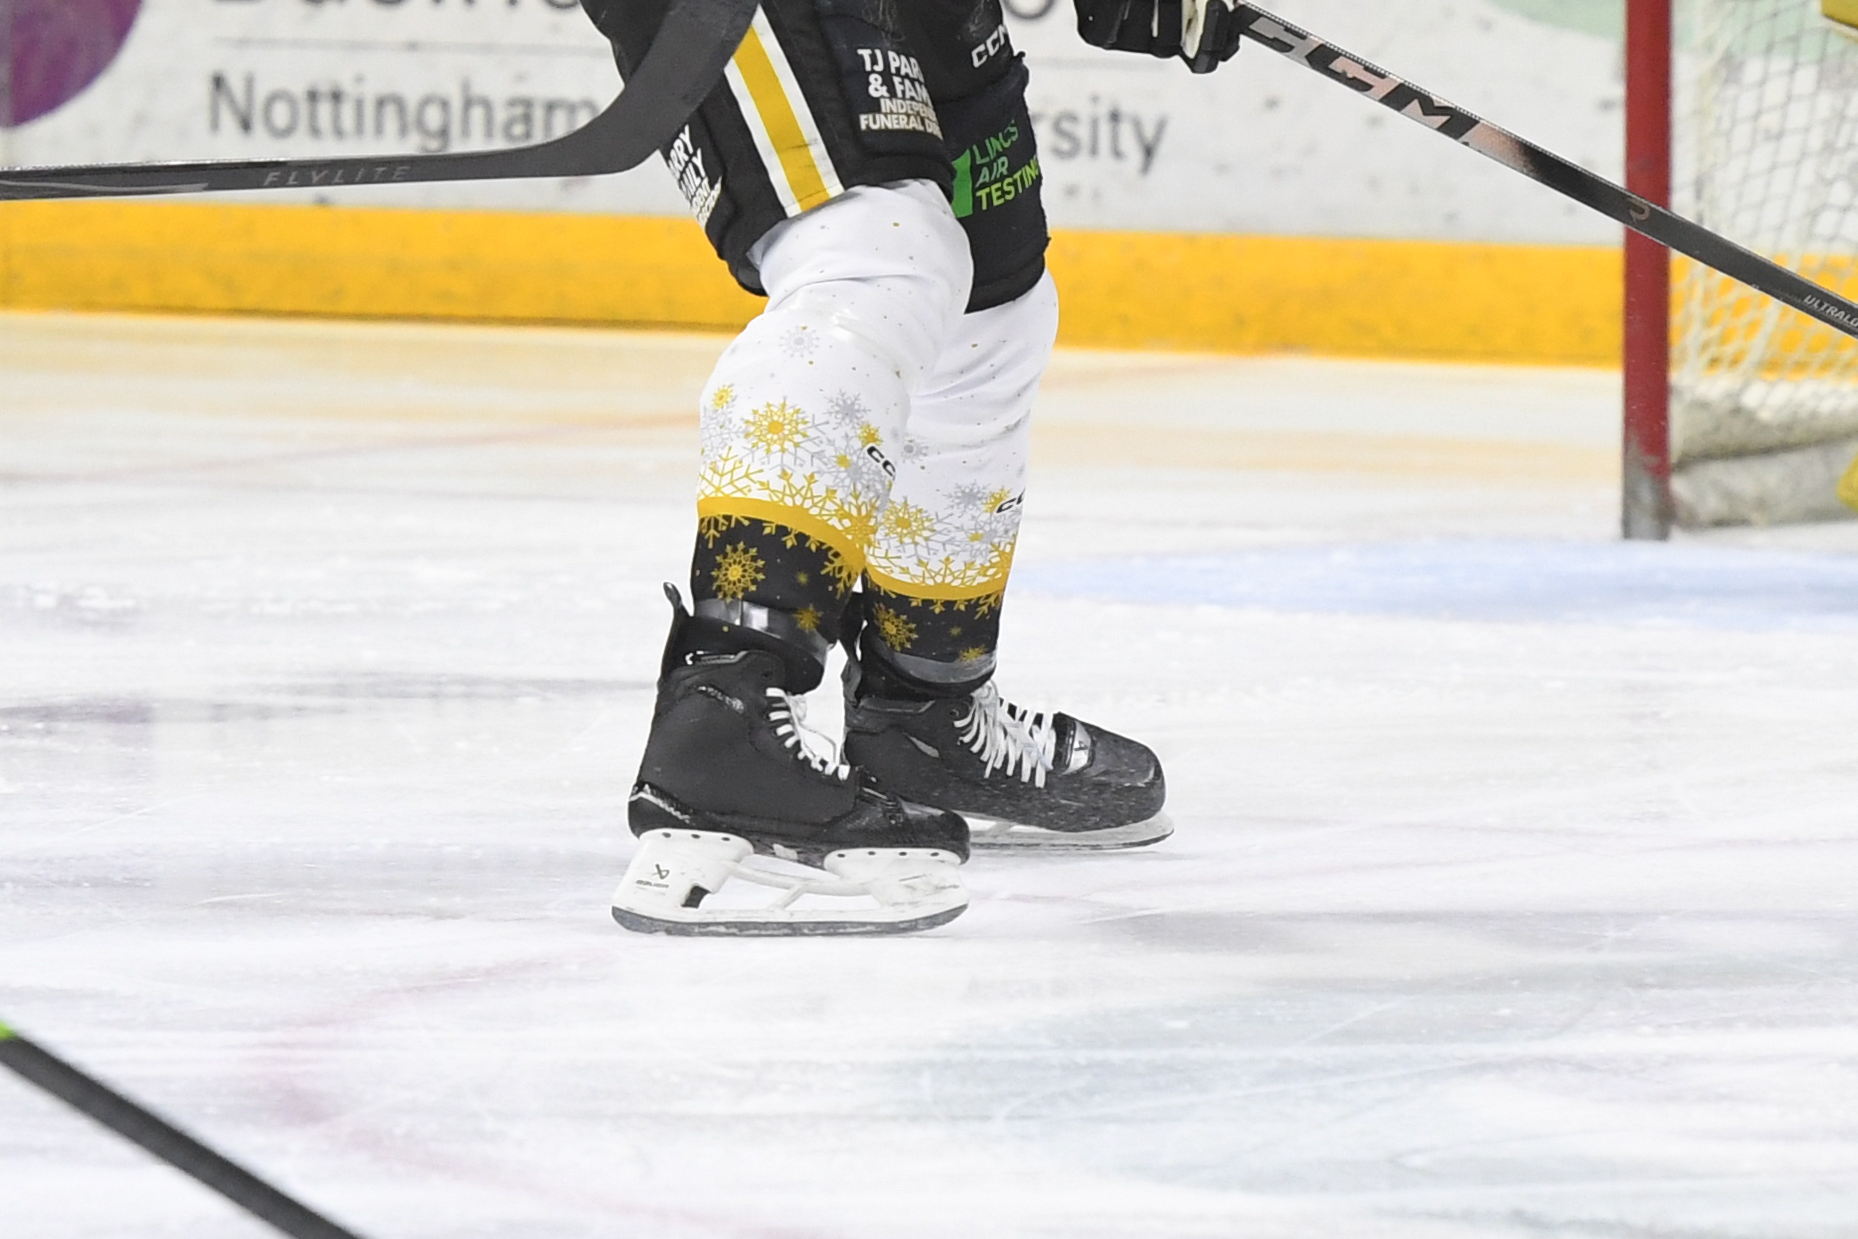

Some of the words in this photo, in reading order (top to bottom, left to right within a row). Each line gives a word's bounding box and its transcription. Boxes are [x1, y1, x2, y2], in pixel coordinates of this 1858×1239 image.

[857, 48, 884, 72] TJ
[888, 50, 925, 84] PAR
[1236, 4, 1481, 141] CCM
[868, 73, 890, 98] &
[892, 76, 934, 110] FAM
[859, 113, 924, 132] FUNERAL
[972, 119, 1020, 166] LINCS
[975, 156, 1010, 188] AIR
[976, 155, 1041, 211] TESTIN
[866, 445, 897, 478] CC
